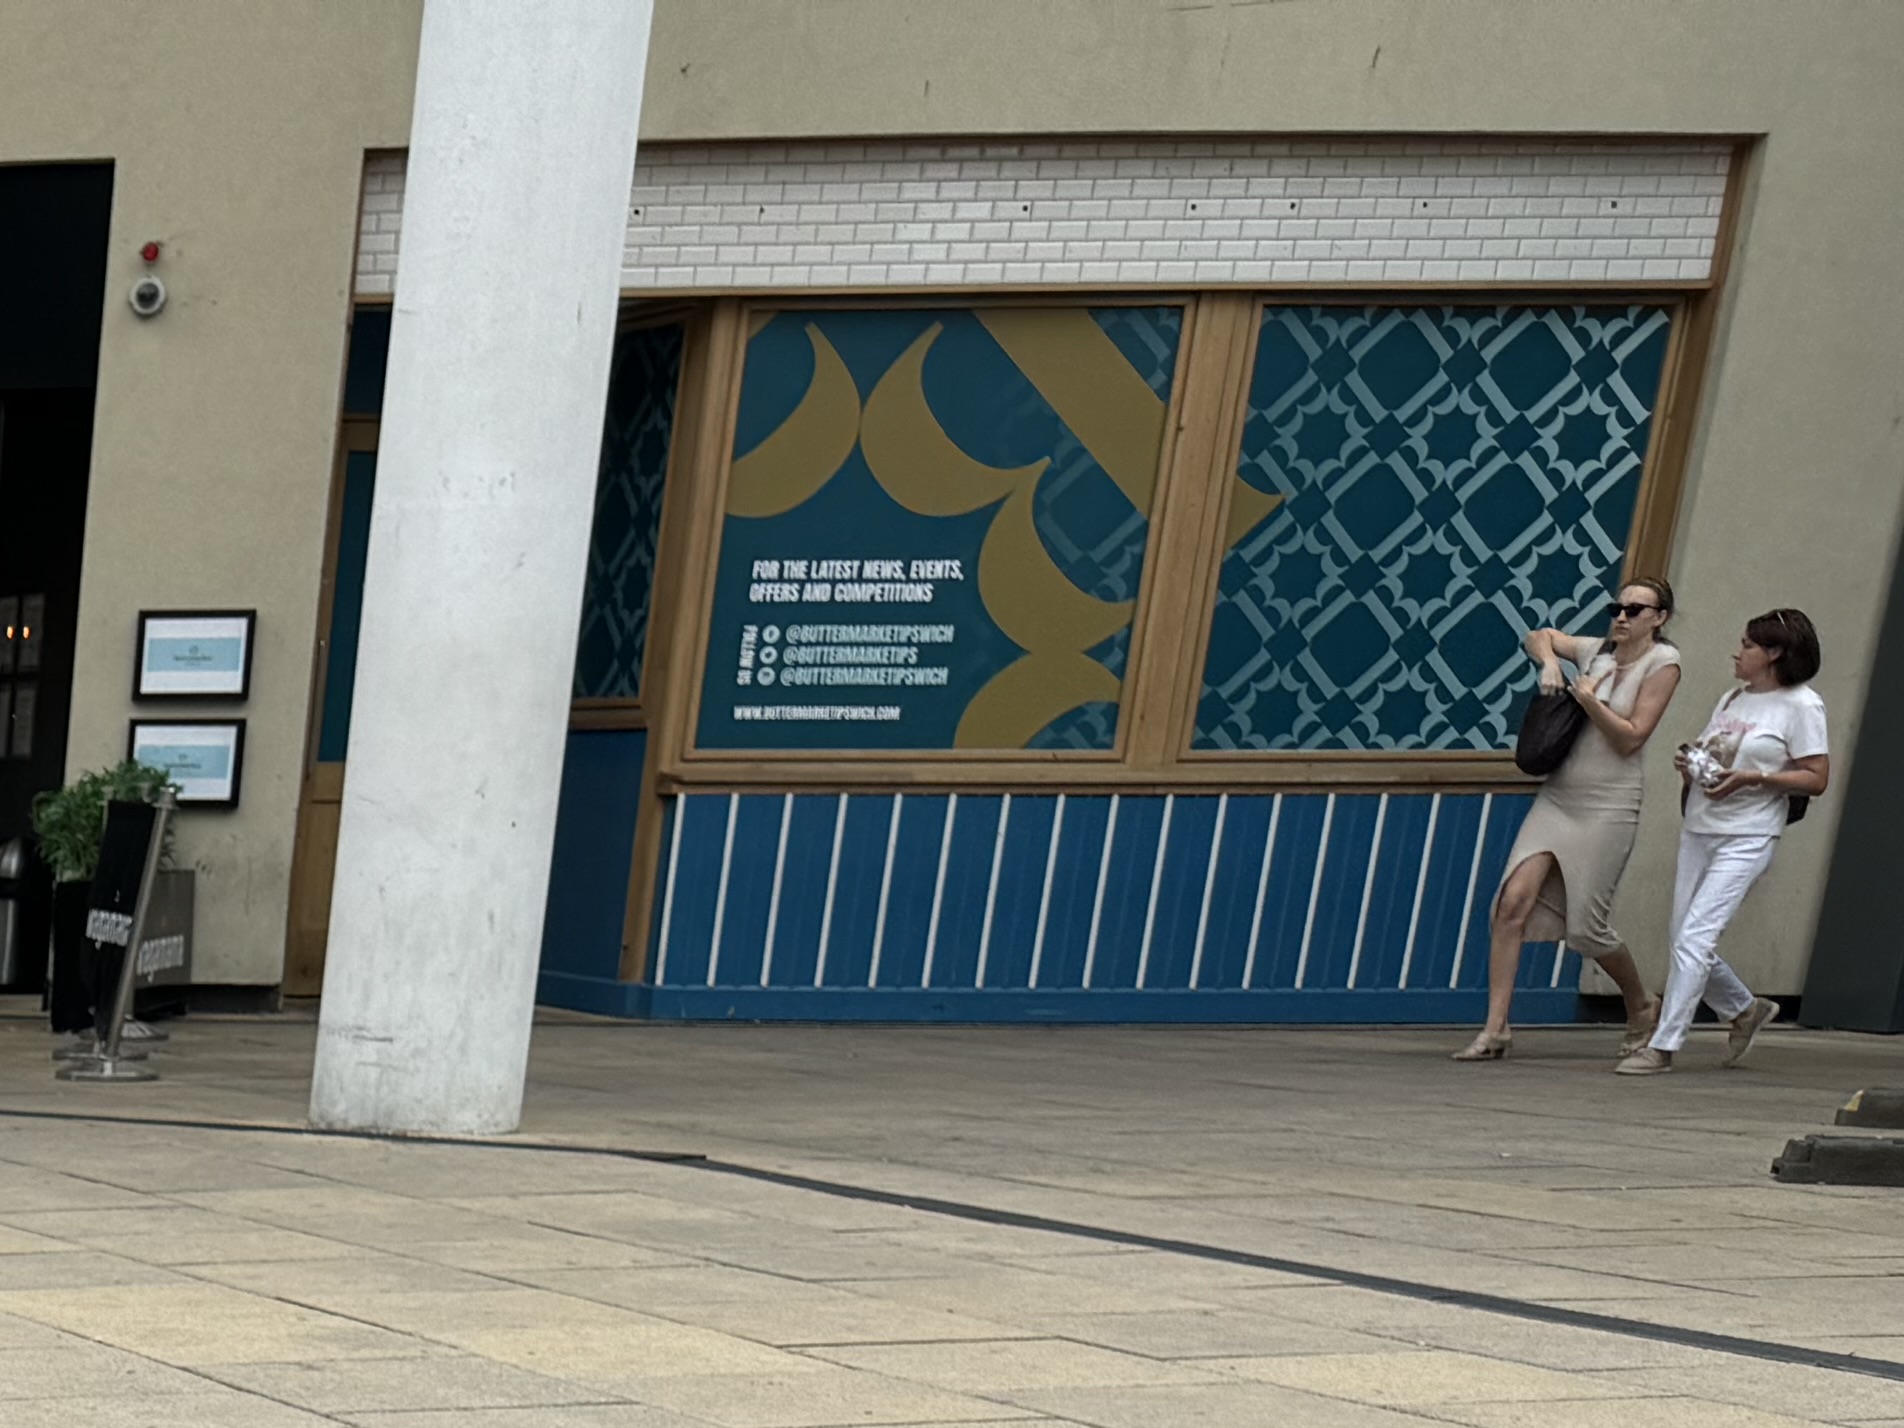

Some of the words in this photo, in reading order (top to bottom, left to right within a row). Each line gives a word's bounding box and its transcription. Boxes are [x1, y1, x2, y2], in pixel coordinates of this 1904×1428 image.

[752, 560, 781, 580] FOR
[783, 560, 809, 580] THE
[811, 560, 861, 580] LATEST
[862, 560, 907, 581] NEWS,
[909, 560, 964, 581] EVENTS,
[749, 583, 801, 602] OFFERS
[802, 583, 832, 602] AND
[834, 583, 935, 602] COMPETITIONS
